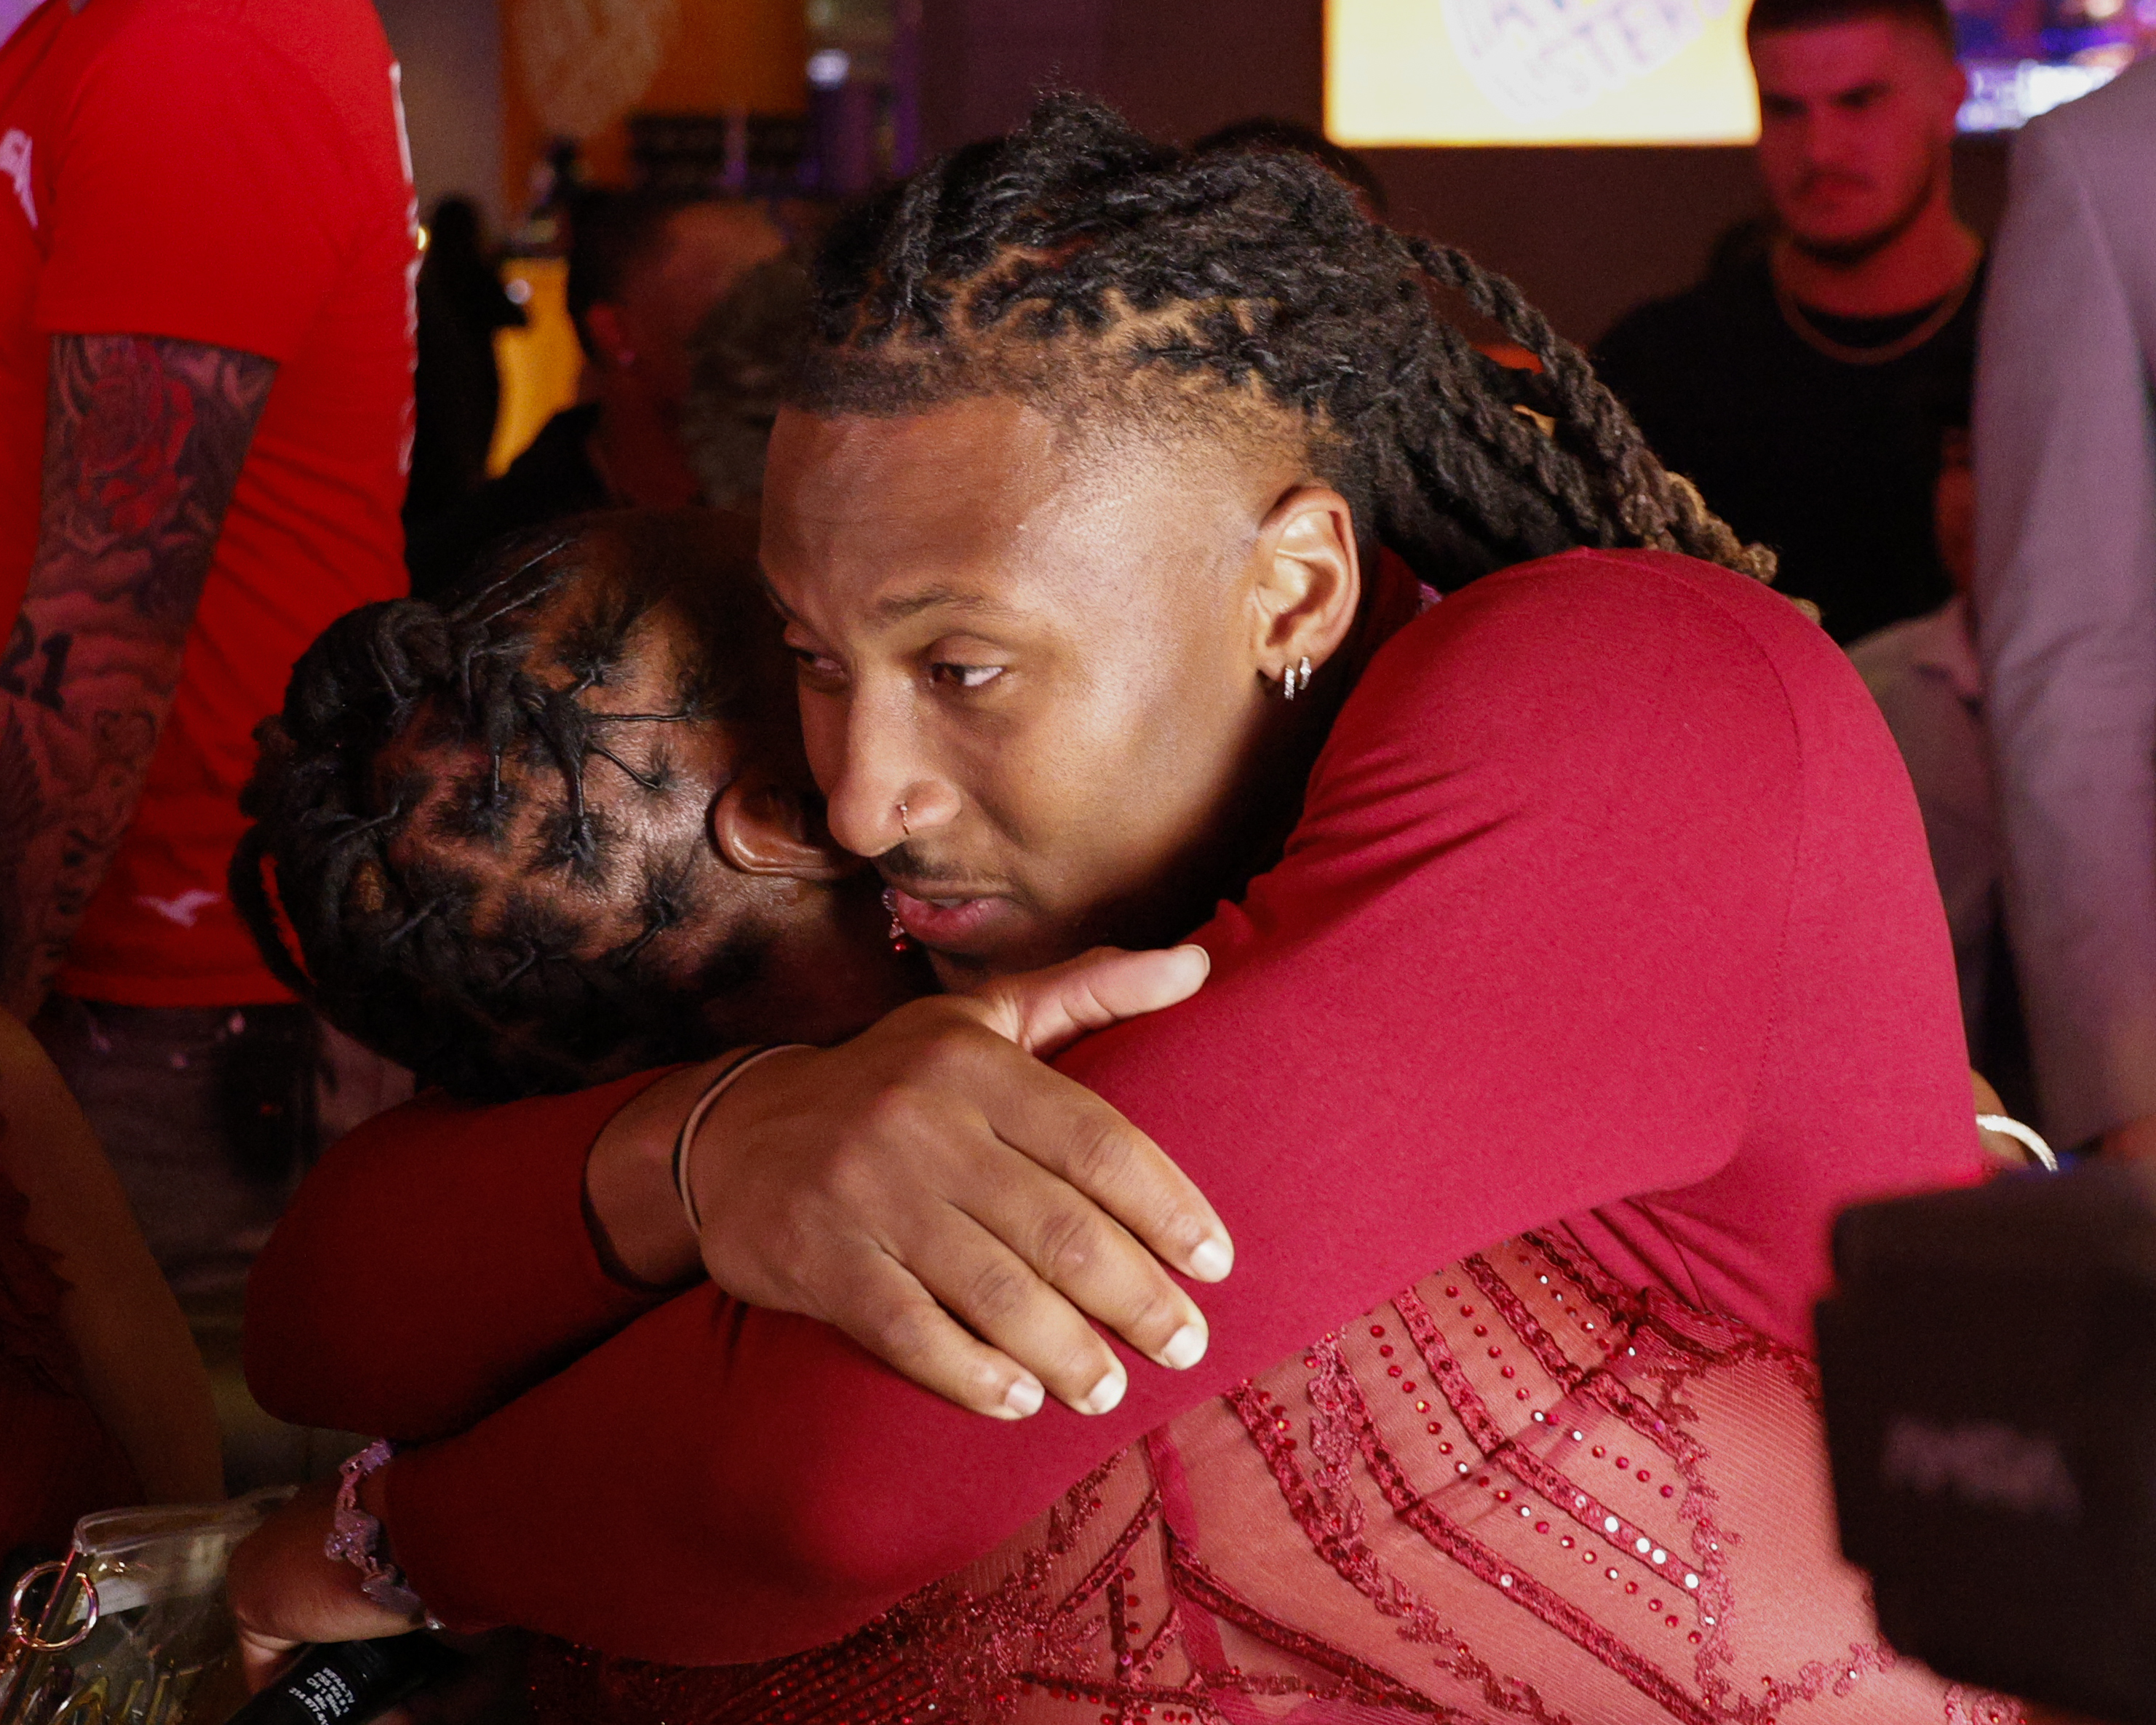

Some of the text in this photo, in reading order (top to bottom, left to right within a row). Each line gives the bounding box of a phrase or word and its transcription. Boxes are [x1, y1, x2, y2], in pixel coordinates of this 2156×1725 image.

[306, 1678, 322, 1689] CH
[325, 1693, 341, 1717] Stick
[314, 1694, 327, 1710] Mic
[322, 1668, 355, 1703] WFAA-TV
